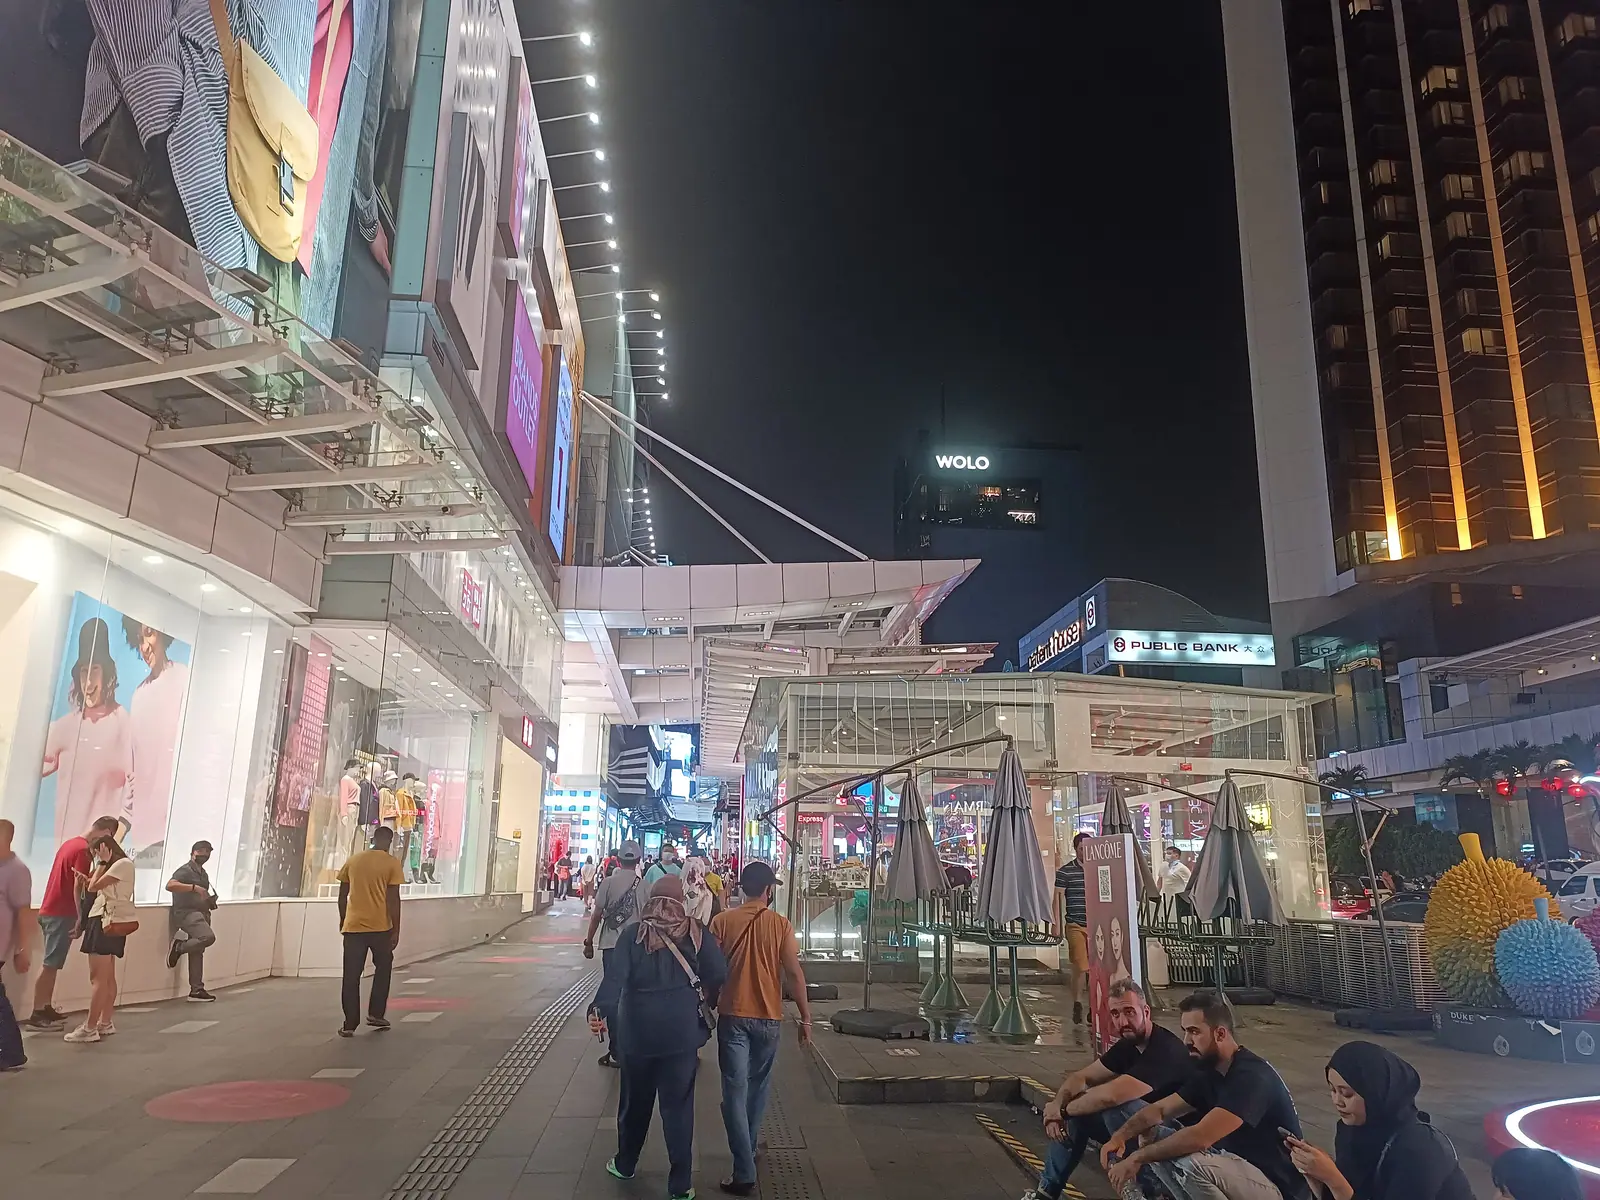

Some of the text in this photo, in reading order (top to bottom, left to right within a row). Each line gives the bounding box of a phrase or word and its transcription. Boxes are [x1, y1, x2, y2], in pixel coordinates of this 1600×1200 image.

[514, 335, 539, 421] BRANDS
[512, 374, 536, 449] OUTLET
[935, 454, 990, 470] WOLO
[1131, 640, 1188, 651] PUBLIC
[1193, 642, 1239, 653] BANK
[797, 815, 824, 823] Express
[1085, 840, 1122, 862] LANCÔME
[1450, 1012, 1474, 1021] DUKE
